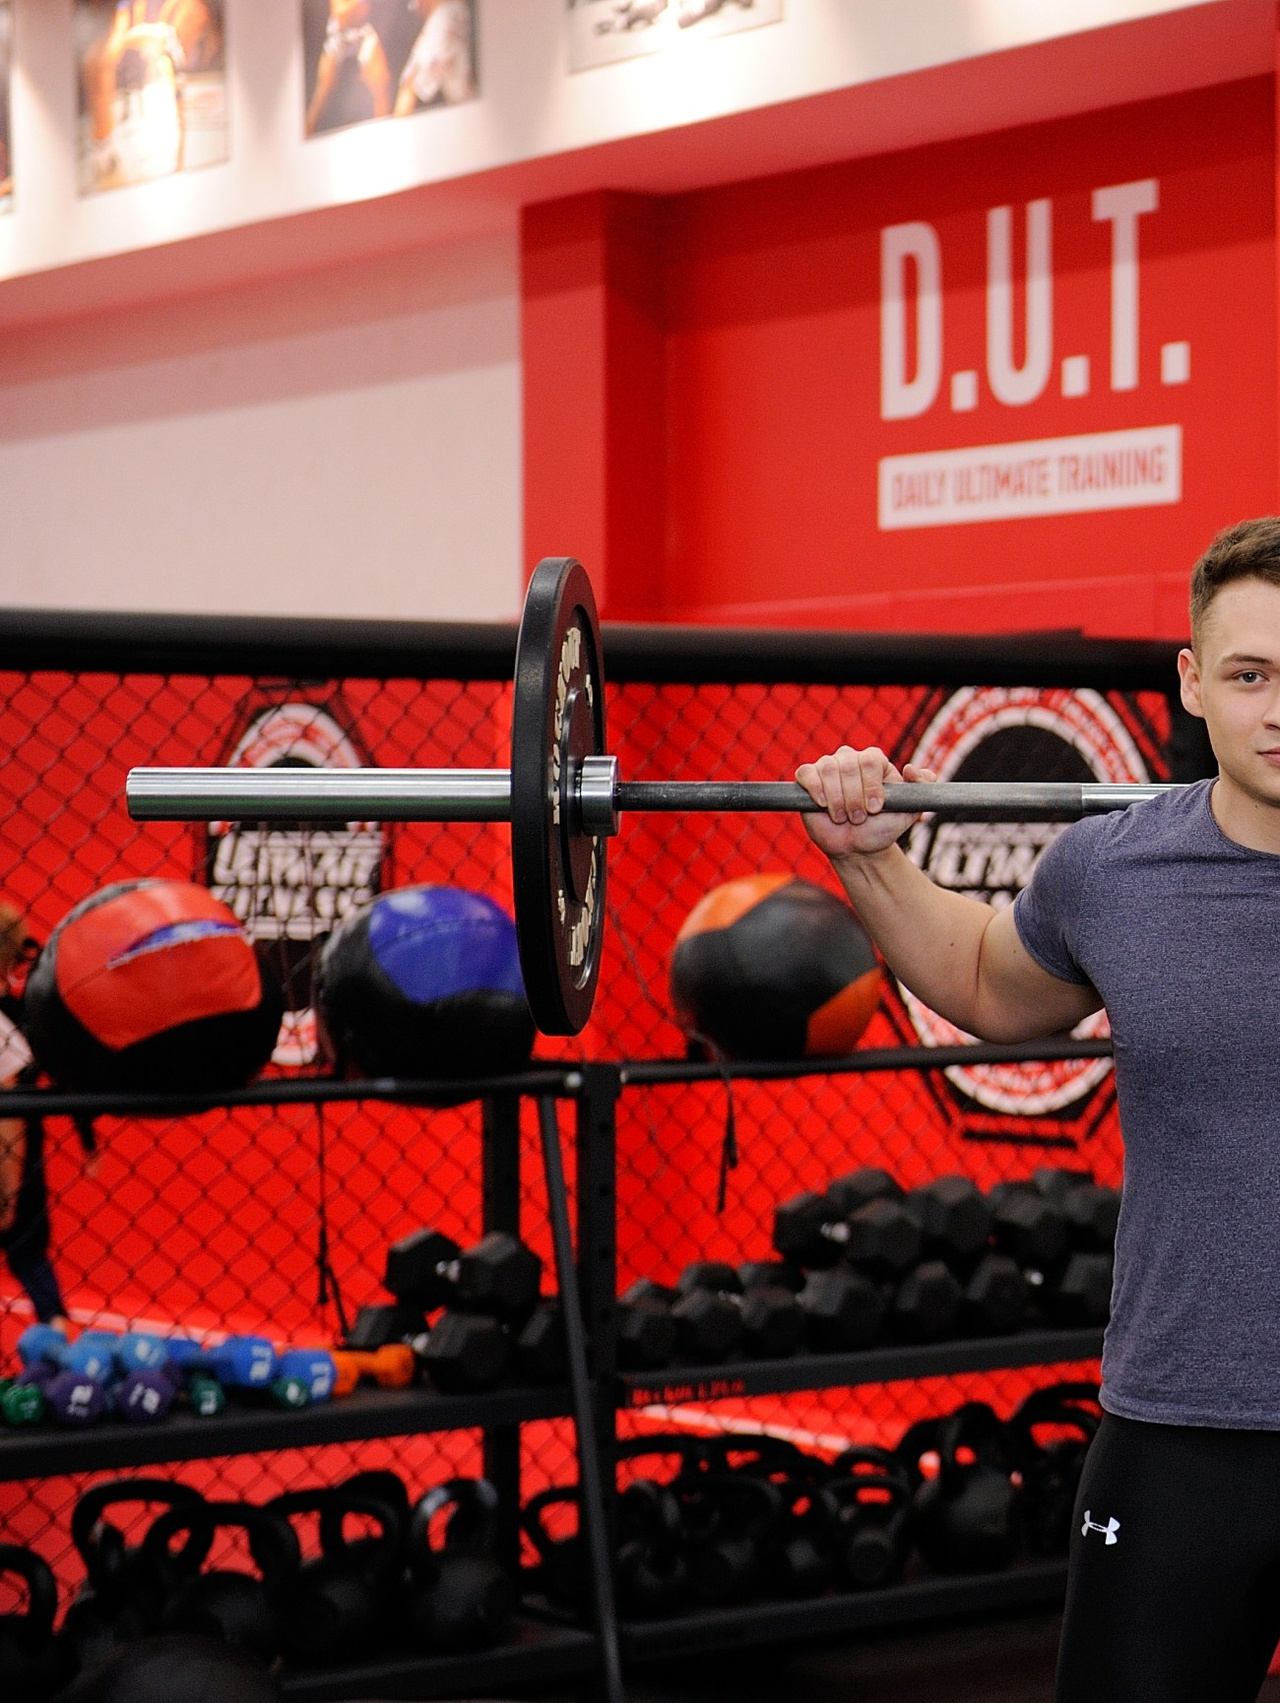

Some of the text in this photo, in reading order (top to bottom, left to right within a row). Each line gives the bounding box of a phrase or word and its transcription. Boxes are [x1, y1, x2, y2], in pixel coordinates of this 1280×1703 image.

[880, 178, 1191, 421] D.U.T.
[893, 446, 1167, 512] DAILY ULTIMATE TRAINING
